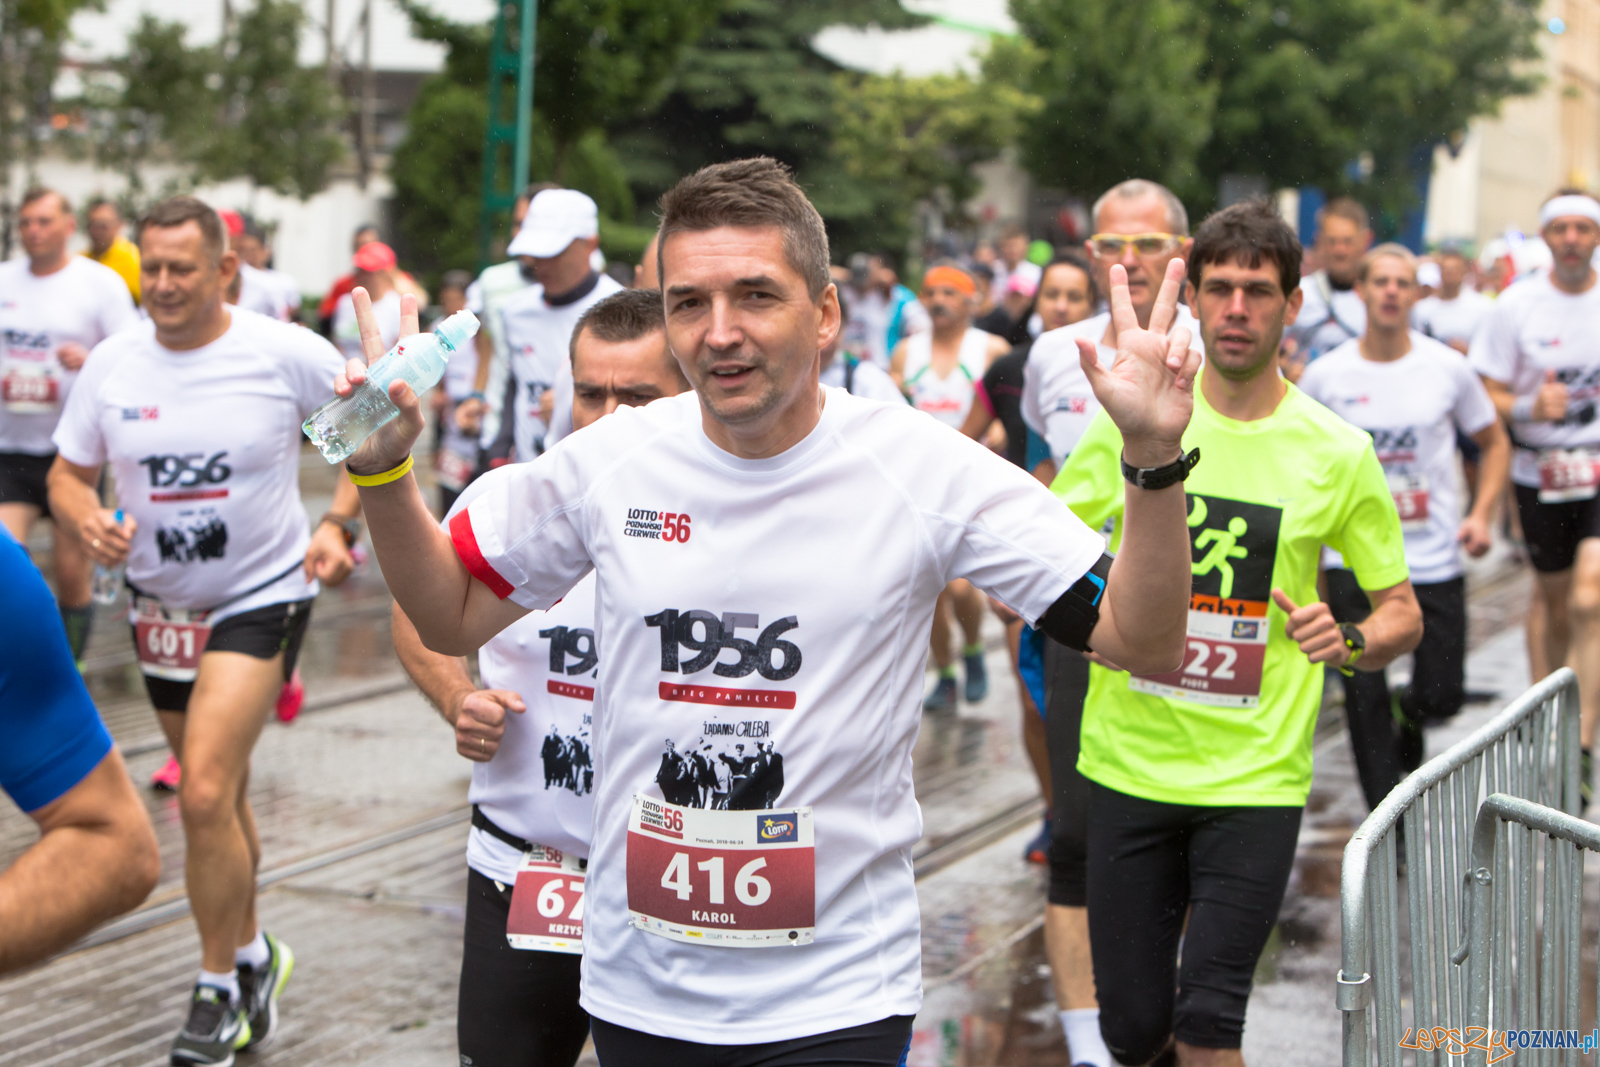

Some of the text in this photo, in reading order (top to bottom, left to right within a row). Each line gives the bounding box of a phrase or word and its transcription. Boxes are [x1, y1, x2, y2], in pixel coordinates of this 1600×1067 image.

[138, 450, 232, 488] 1956
[627, 508, 658, 521] LOTTO
[625, 520, 662, 531] POZNAŃSKI
[623, 527, 661, 540] CZERWIEC
[147, 625, 195, 659] 601
[644, 608, 803, 682] 1956
[672, 688, 778, 703] BIEG PAMIĘCI
[703, 720, 770, 738] ŻĄDAMY CHLEBA
[642, 799, 661, 813] LOTTO
[767, 823, 788, 836] LOTTO
[660, 851, 772, 907] 416
[692, 910, 737, 924] KAROL
